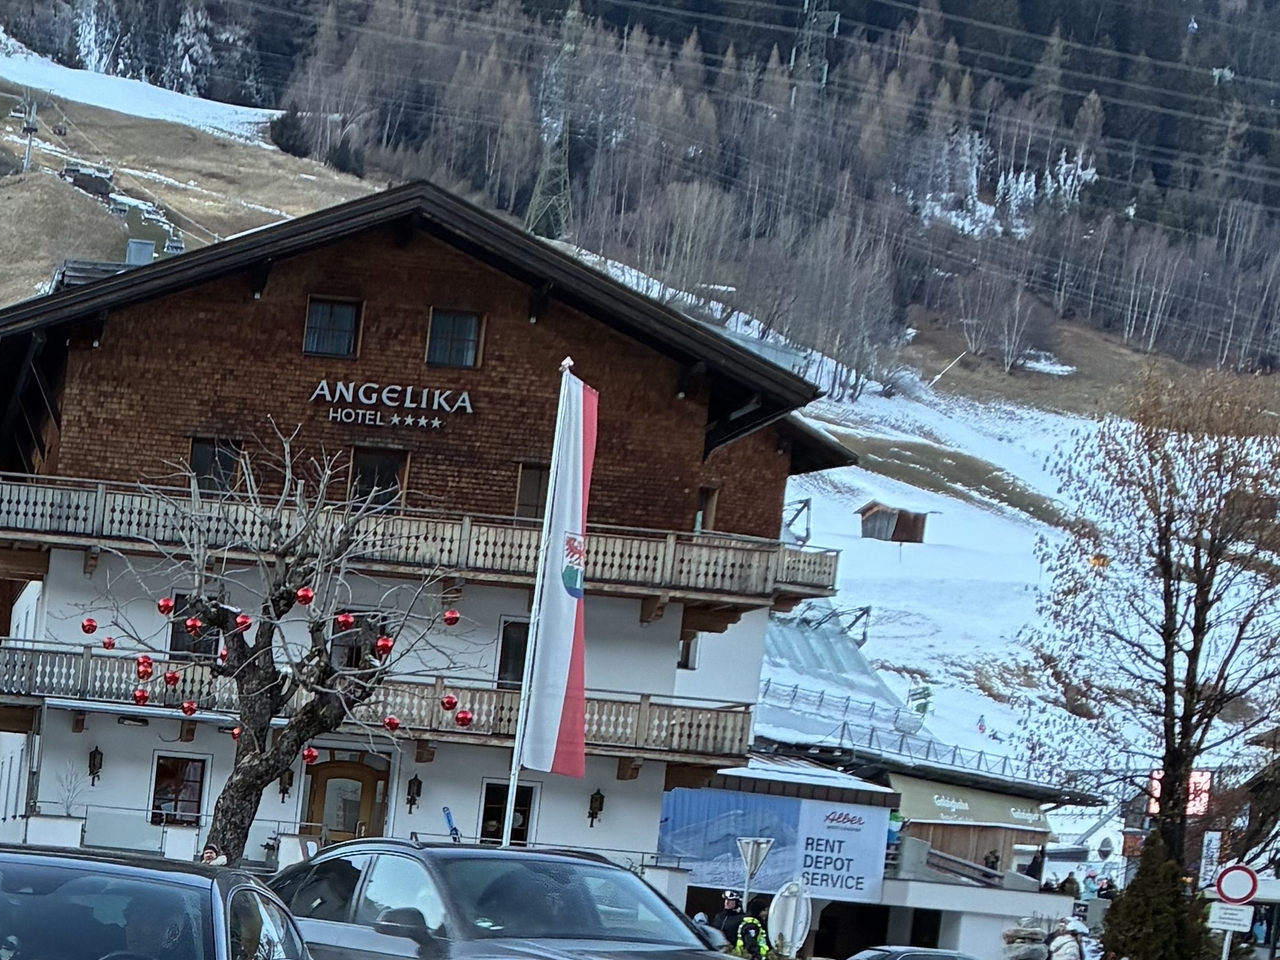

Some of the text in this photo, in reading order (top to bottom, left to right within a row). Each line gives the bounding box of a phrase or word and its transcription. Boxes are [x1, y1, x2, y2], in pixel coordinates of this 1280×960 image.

[309, 379, 474, 414] ANGELIKA
[328, 407, 385, 426] HOTEL
[824, 811, 865, 825] Alber
[804, 837, 846, 854] RENT
[803, 854, 855, 872] DEPOT
[801, 871, 865, 890] SERVICE
